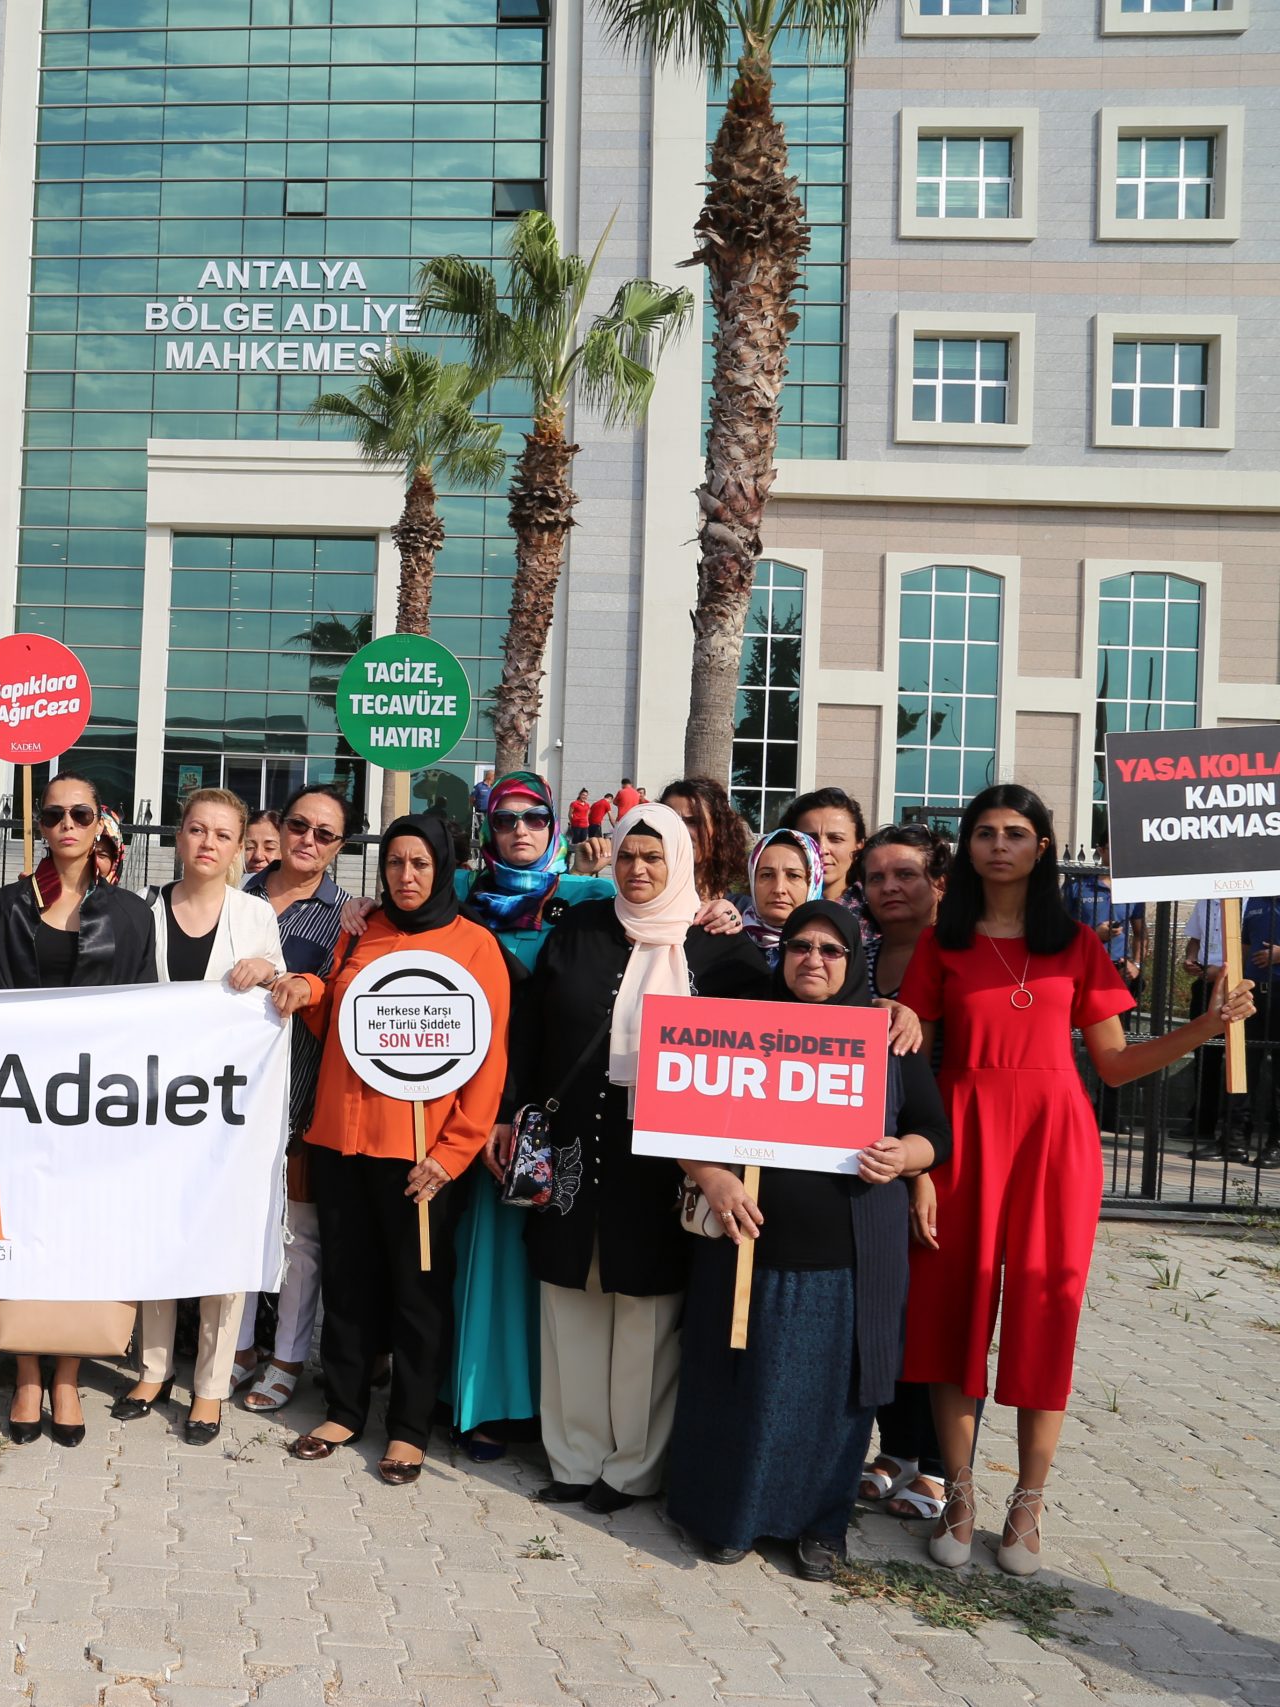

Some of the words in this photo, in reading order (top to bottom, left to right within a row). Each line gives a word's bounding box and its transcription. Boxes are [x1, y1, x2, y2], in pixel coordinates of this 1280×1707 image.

[197, 261, 367, 290] ANTALYA
[145, 296, 274, 332] BÖLGE
[283, 297, 421, 333] ADLİYE
[165, 336, 393, 372] MAHKEMESİ
[364, 657, 444, 687] TACİZE,
[349, 690, 457, 716] TECAVÜZE
[10, 742, 42, 751] KADEM
[370, 726, 441, 748] HAYIR!
[1115, 756, 1197, 783] YASA
[1185, 782, 1276, 810] KADIN
[1141, 812, 1280, 843] KORKMAS
[1213, 879, 1255, 890] KADEM
[368, 1019, 386, 1030] Her
[389, 1019, 417, 1030] Türlü
[420, 1019, 461, 1032] Şiddete
[376, 1005, 420, 1016] Herkese
[423, 1005, 451, 1019] Karşı
[379, 1033, 410, 1048] SON
[414, 1033, 450, 1048] VER!
[660, 1025, 755, 1050] KADINA
[759, 1028, 866, 1058] ŞİDDETE
[656, 1051, 768, 1099] DUR
[778, 1059, 865, 1107] DE!
[733, 1144, 775, 1158] KADEM
